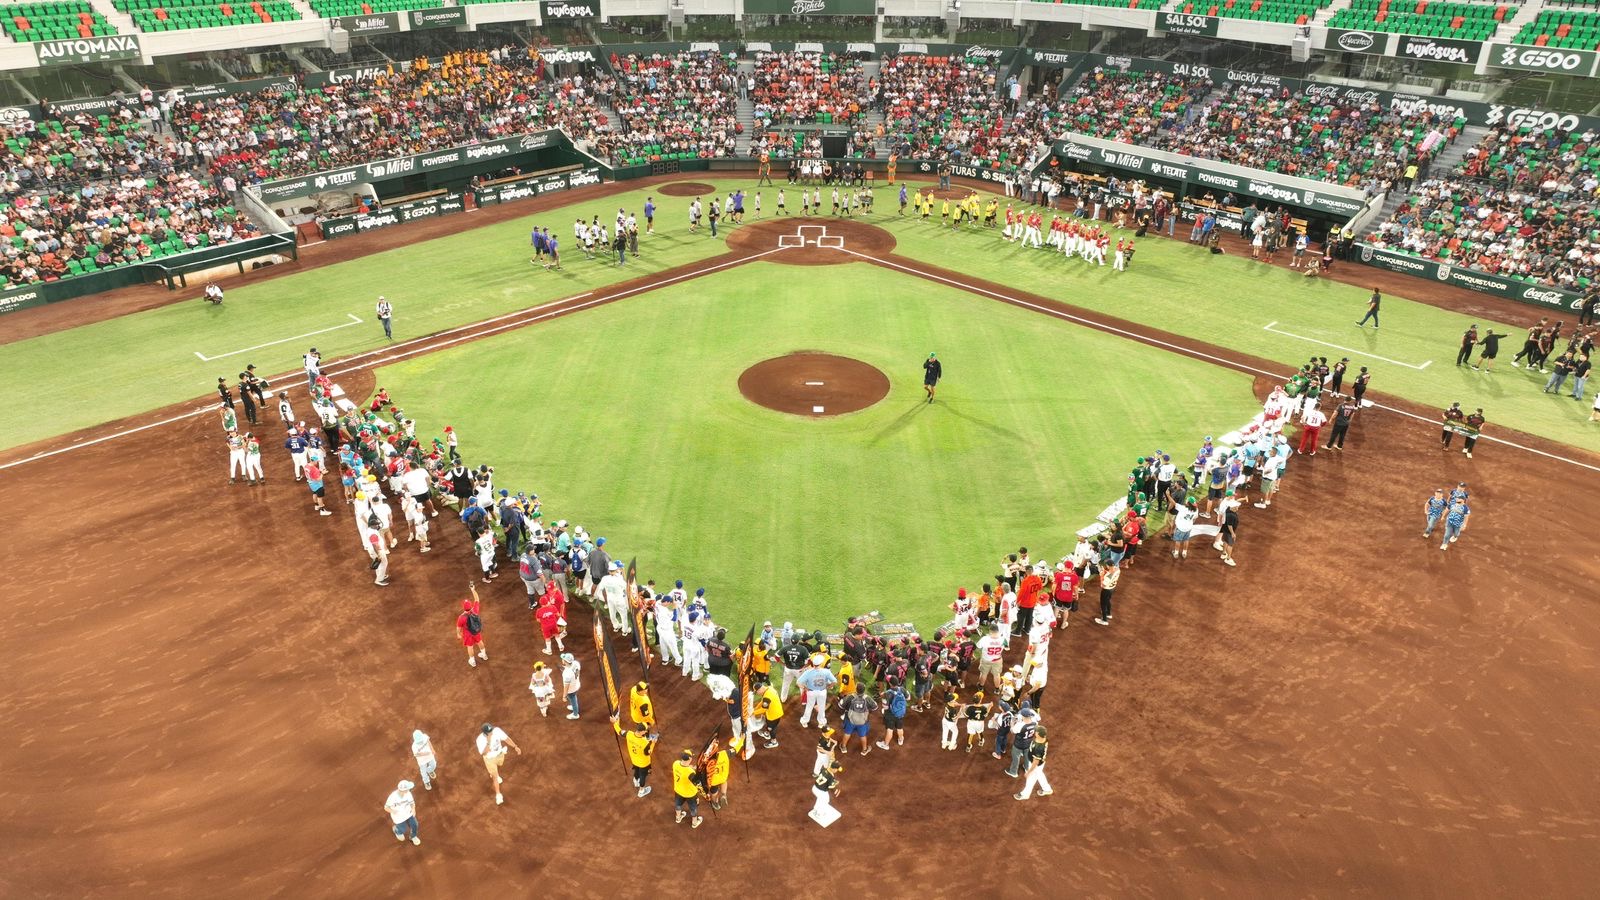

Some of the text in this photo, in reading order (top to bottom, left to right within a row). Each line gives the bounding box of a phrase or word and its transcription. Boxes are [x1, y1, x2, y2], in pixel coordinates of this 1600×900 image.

[367, 18, 386, 28] Mifel
[1166, 13, 1208, 28] SAL SOL
[40, 36, 138, 58] AUTOMAYA
[1406, 42, 1469, 62] DUNOSUSA
[1044, 53, 1068, 63] TECATE
[1519, 50, 1581, 69] G500
[1173, 63, 1210, 79] SAL SOL
[60, 99, 106, 112] MITSUBISHI
[387, 158, 414, 175] Mifel
[422, 153, 459, 167] POWERADE
[1116, 153, 1144, 169] Mifel
[328, 171, 357, 184] TECATE
[1162, 165, 1188, 178] TECATE
[1198, 172, 1238, 188] POWERADE
[412, 205, 436, 217] G500
[335, 223, 354, 234] G500
[1376, 254, 1424, 271] CONQUISTADOR
[1453, 272, 1507, 291] CONQUISTADOR
[789, 654, 798, 662] 17
[987, 646, 1002, 656] 52
